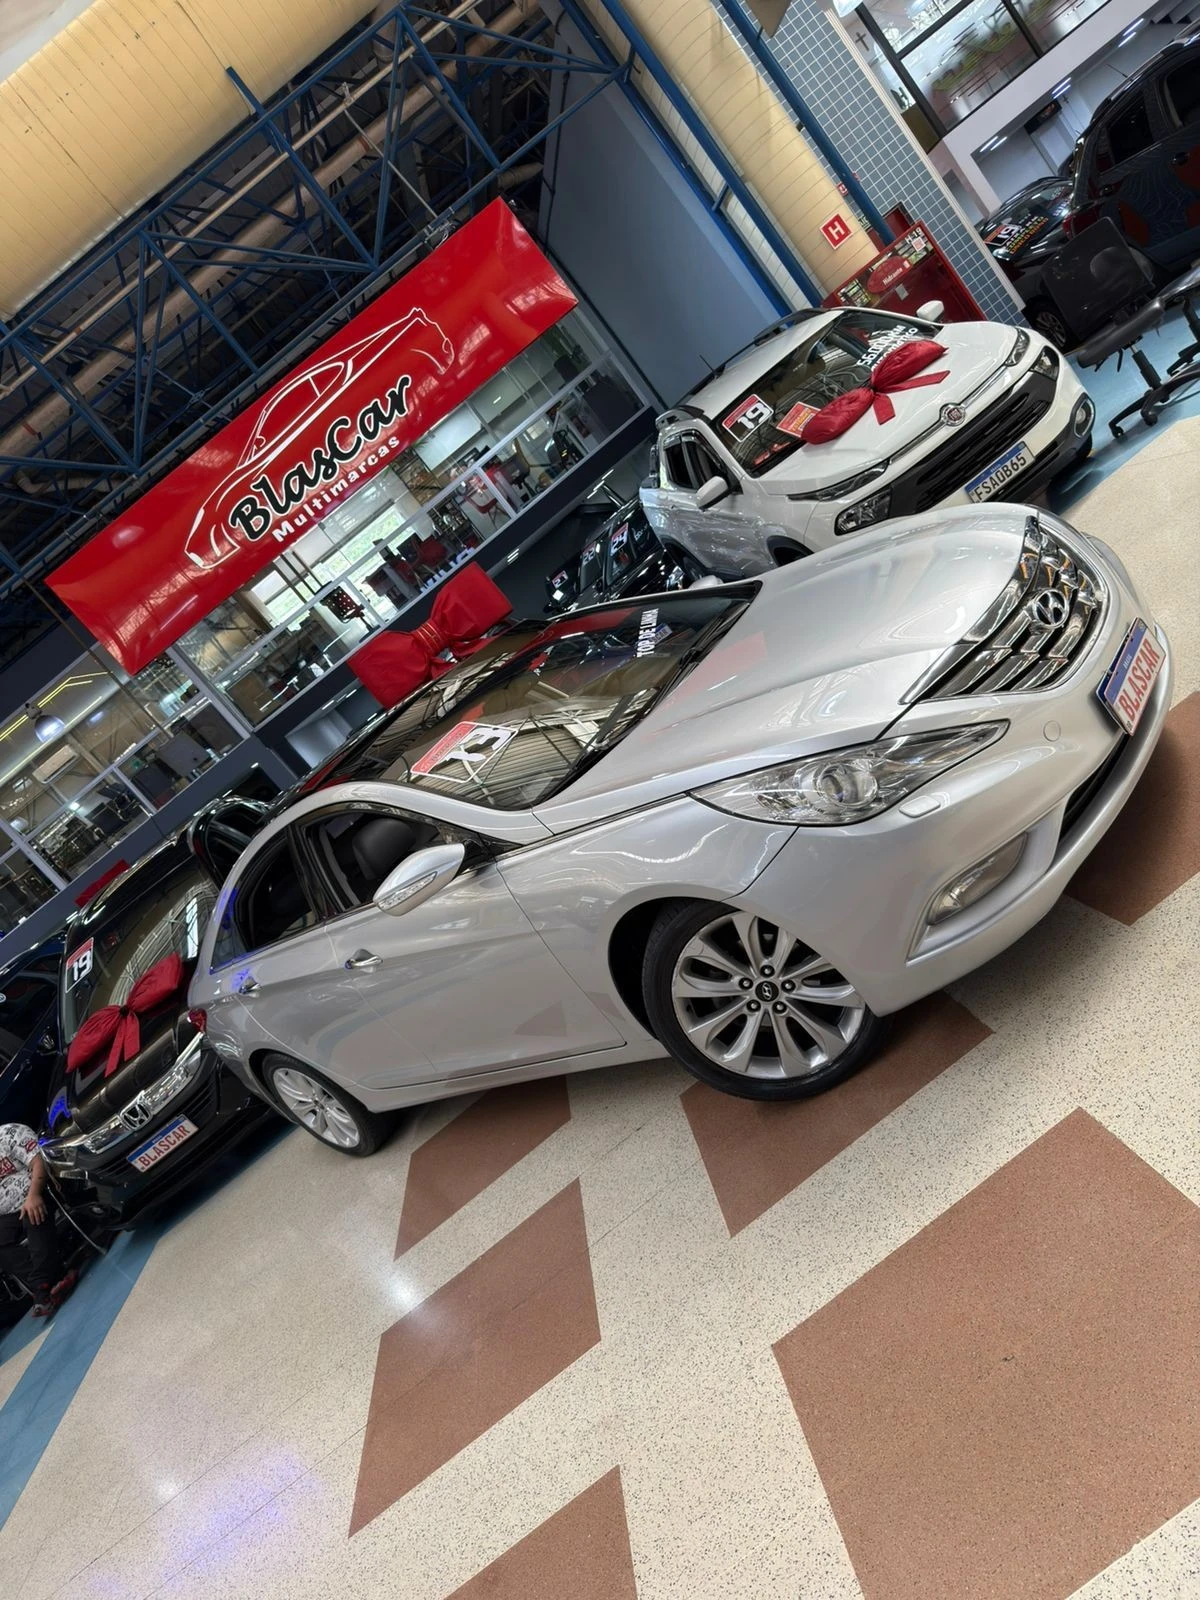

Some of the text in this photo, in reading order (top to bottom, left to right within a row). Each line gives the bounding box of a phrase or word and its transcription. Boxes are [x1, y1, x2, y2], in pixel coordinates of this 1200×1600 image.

[828, 221, 845, 241] H
[738, 402, 771, 430] 19
[228, 375, 412, 542] BlasCar
[974, 452, 1027, 501] FSA0B65
[272, 436, 400, 542] Multimarcas
[636, 639, 656, 657] TOP
[638, 628, 656, 640] DE
[1119, 639, 1160, 722] BLASCAR
[73, 951, 91, 981] 19
[138, 1125, 190, 1167] BLASCAR
